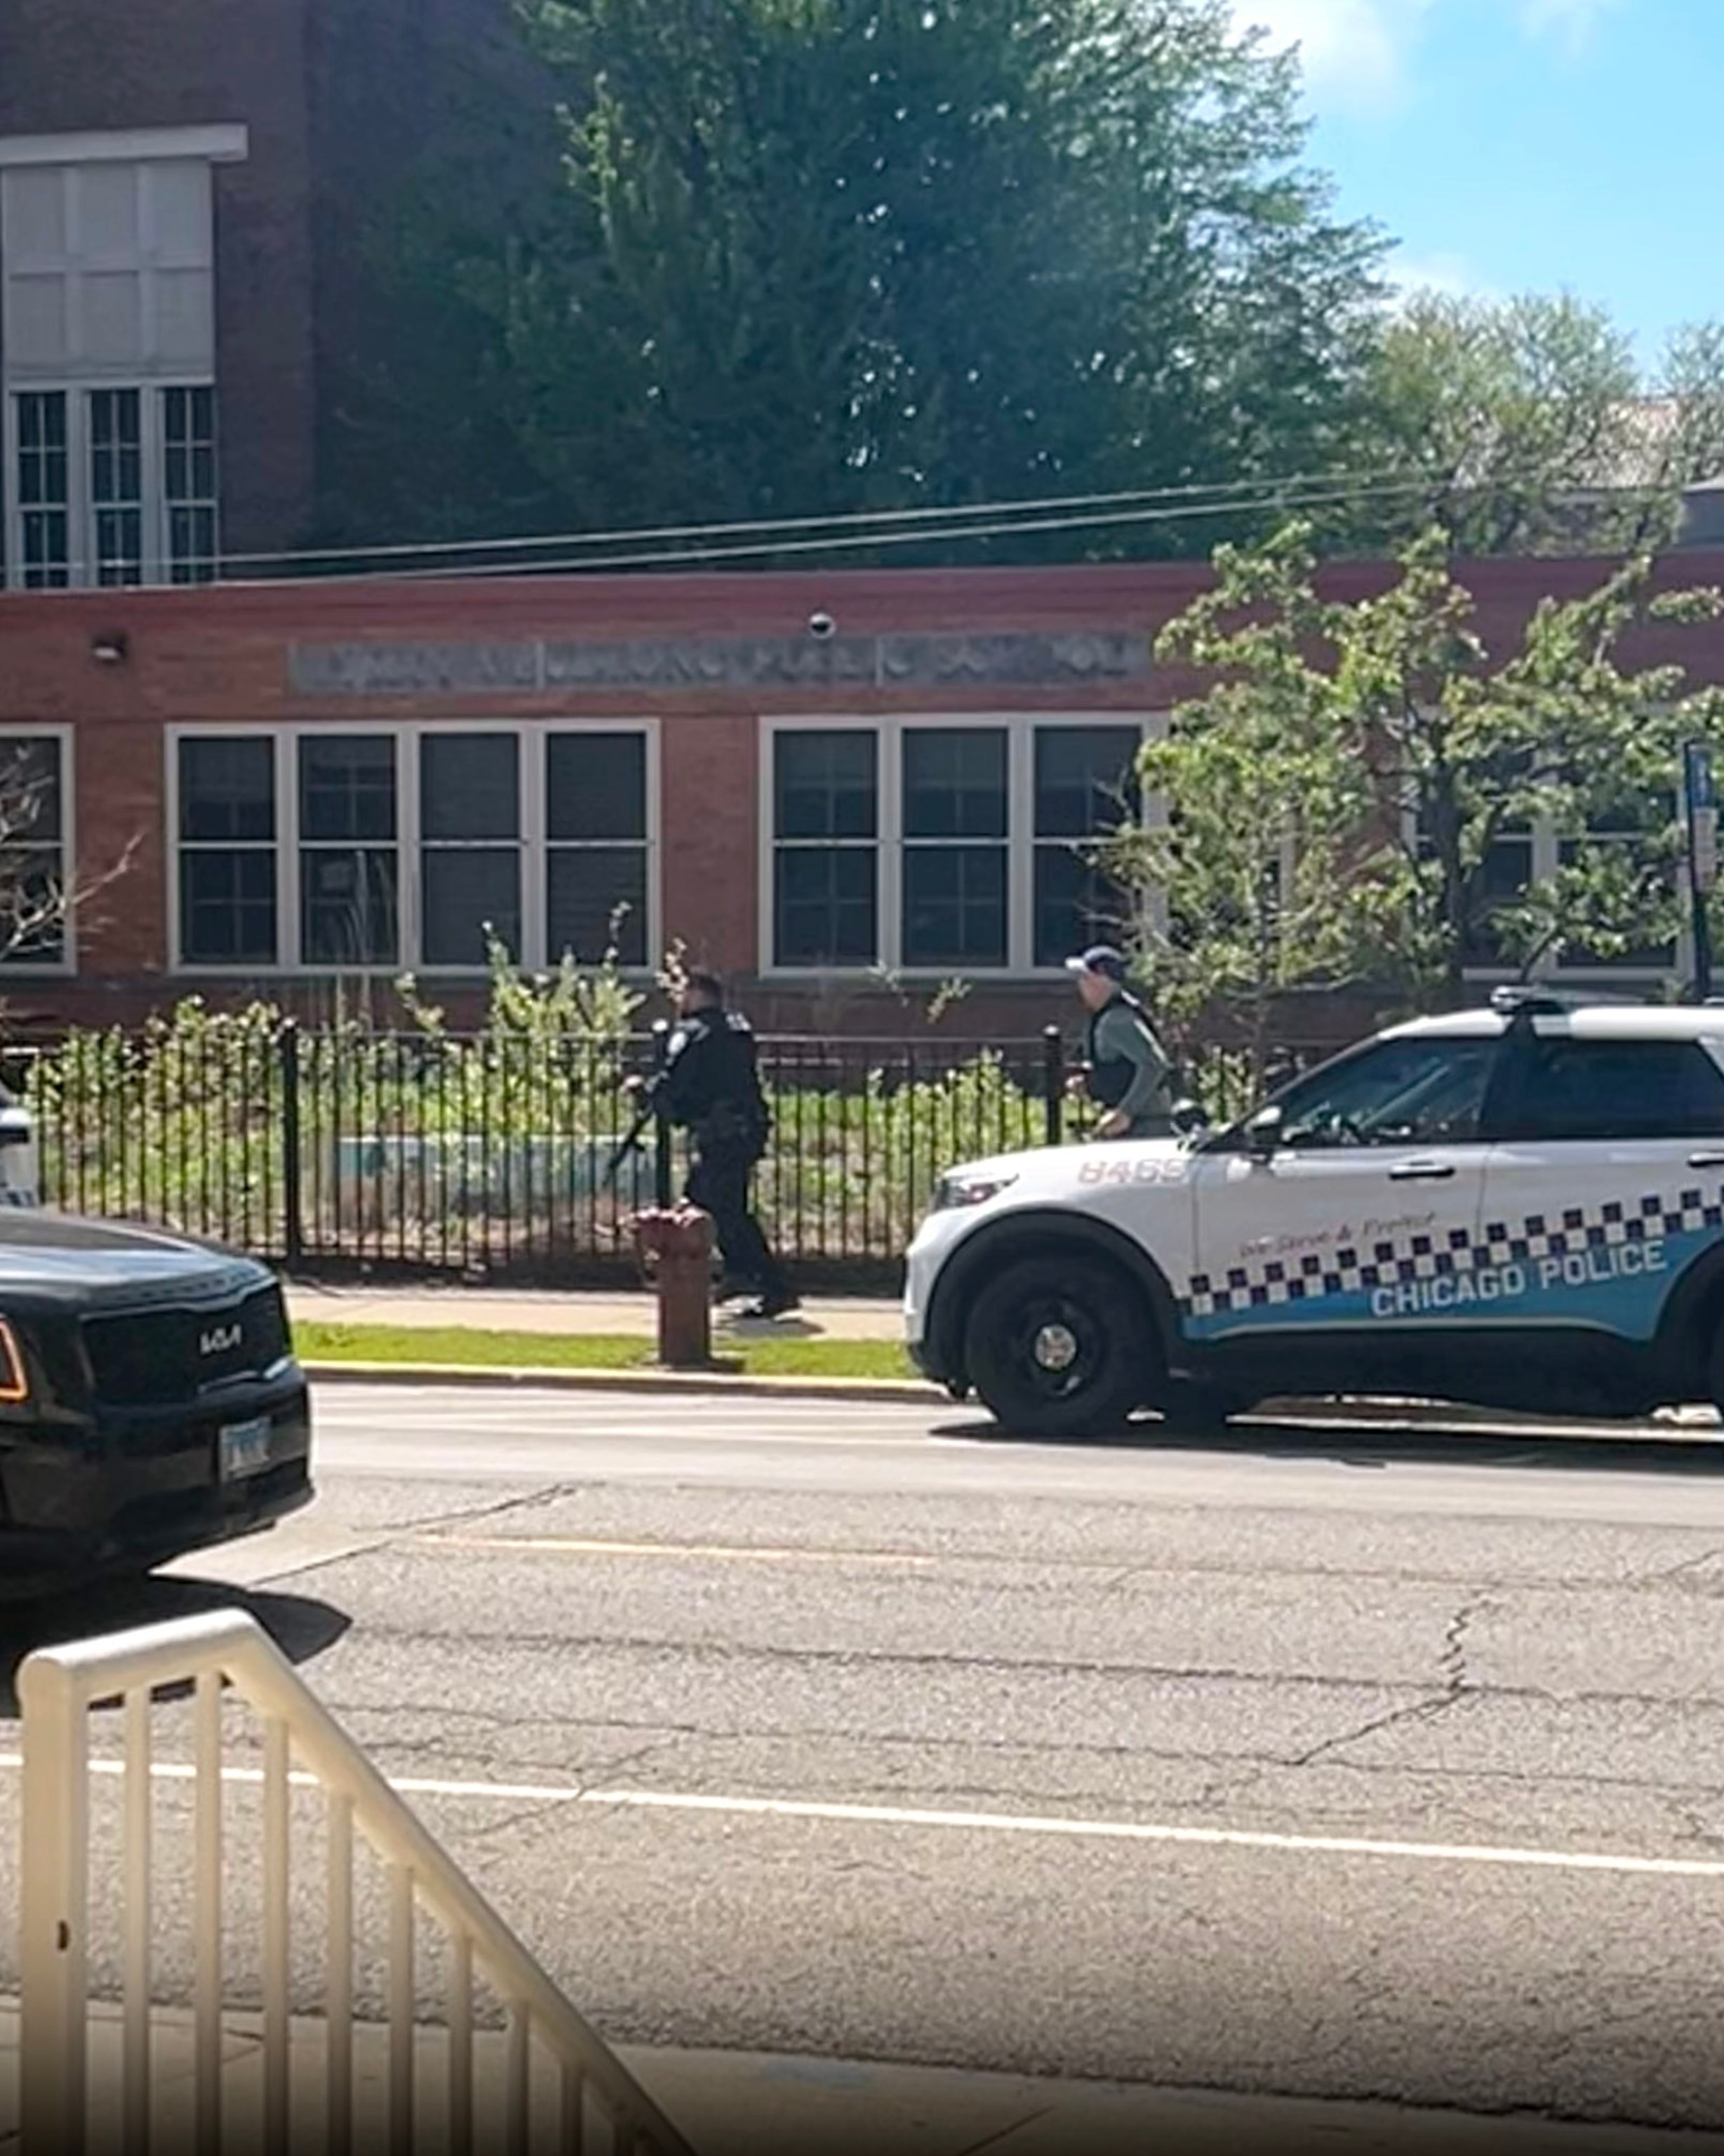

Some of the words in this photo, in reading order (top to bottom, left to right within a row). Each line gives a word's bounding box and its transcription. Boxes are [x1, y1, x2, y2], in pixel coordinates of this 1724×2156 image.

[1372, 1267, 1525, 1317] CHICAGO
[1540, 1241, 1666, 1289] POLICE
[201, 1324, 241, 1355] KIA
